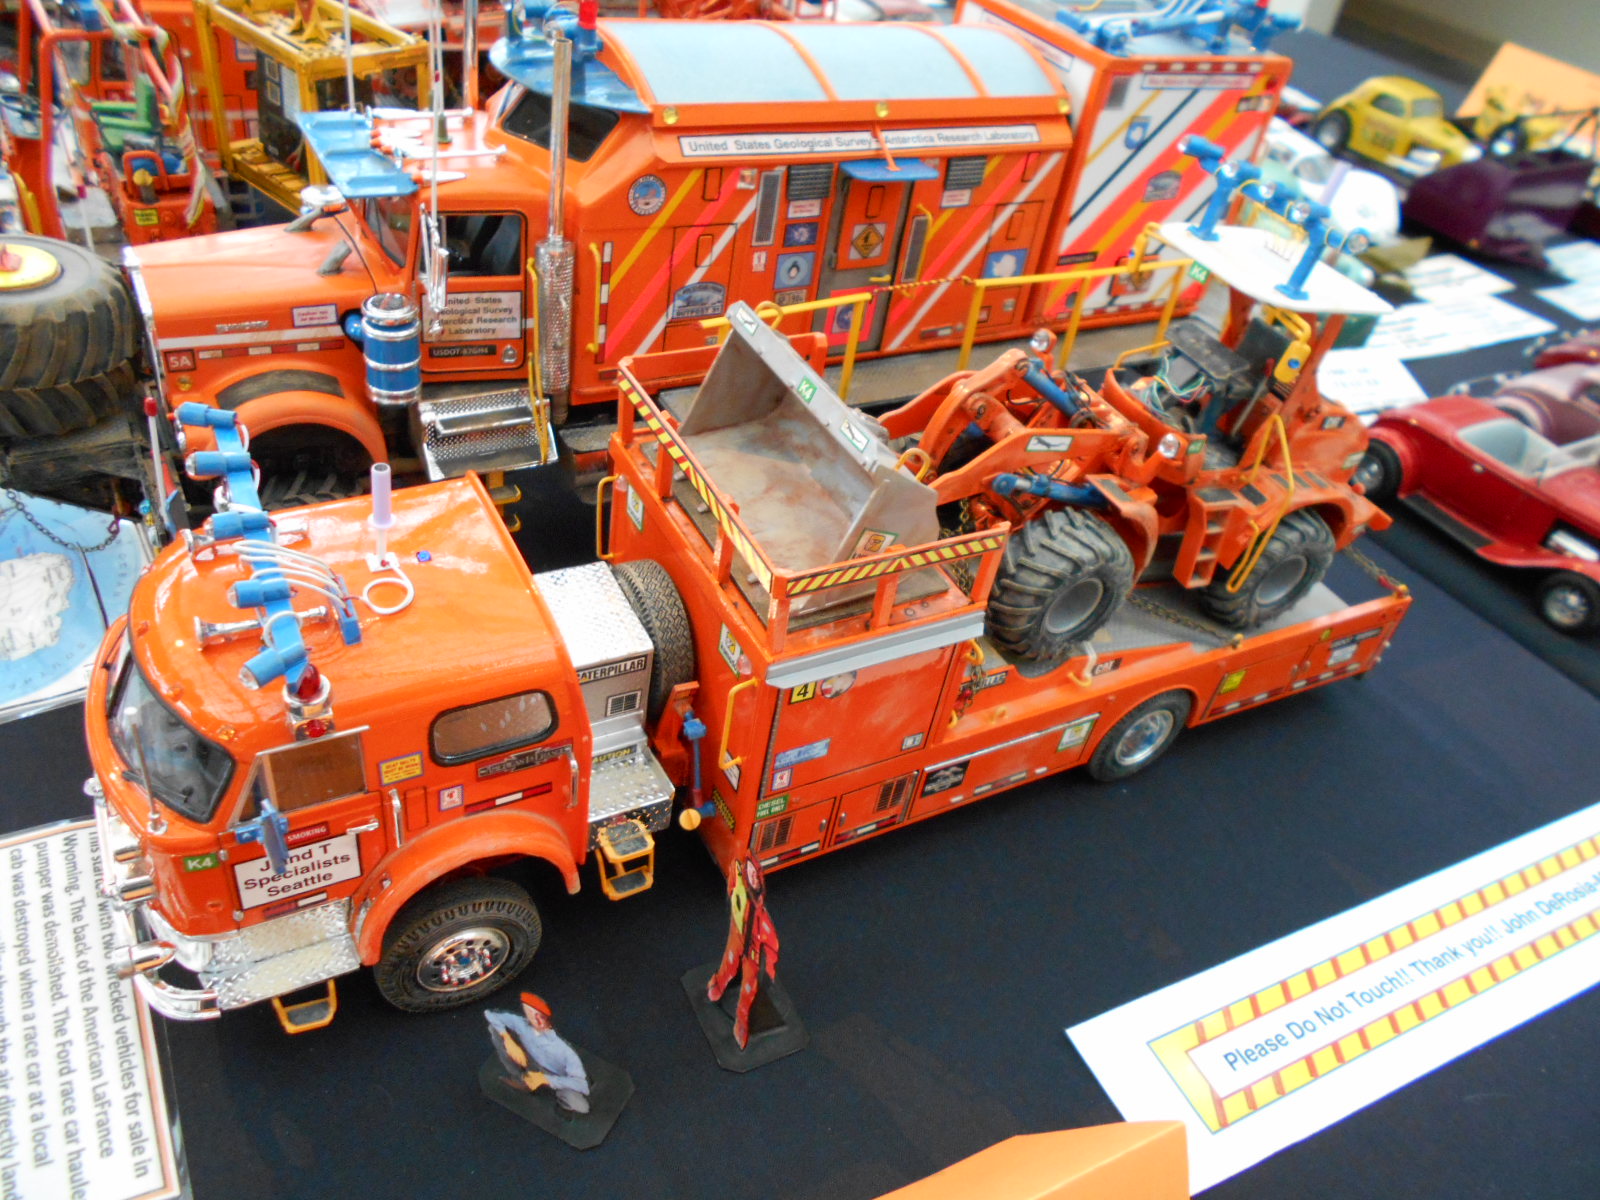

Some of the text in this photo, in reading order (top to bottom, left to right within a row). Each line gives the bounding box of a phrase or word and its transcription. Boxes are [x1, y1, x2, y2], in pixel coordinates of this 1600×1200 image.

[688, 139, 728, 152] United
[734, 138, 771, 150] States
[774, 135, 832, 151] Geological
[835, 134, 872, 148] Survey
[937, 132, 984, 142] Research
[440, 306, 513, 316] eological Survey
[448, 296, 502, 305] nited States
[429, 316, 517, 326] tarctica Research
[448, 327, 496, 335] Laboratory
[796, 683, 809, 698] 4
[593, 748, 631, 763] AUTION
[287, 826, 327, 842] SMOKING
[34, 841, 53, 889] pumper
[244, 854, 351, 890] Specialists
[260, 843, 331, 872] J nd T
[268, 872, 333, 897] Seattle
[42, 893, 54, 919] was
[98, 901, 112, 931] with
[44, 920, 68, 1006] demolished.
[60, 833, 114, 1159] Wyoming. The back of the American LaFrance
[107, 963, 130, 1024] wrecked
[1223, 1033, 1289, 1072] Please
[1285, 1019, 1317, 1040] Do
[1314, 1000, 1352, 1026] Not
[1346, 968, 1414, 1008] Touch!!
[1408, 944, 1462, 977] Thank
[1461, 925, 1504, 957] you!!
[1501, 909, 1541, 934] John
[10, 849, 54, 1168] cab was destroyed when a race car at a local
[52, 1007, 69, 1039] The
[56, 1040, 77, 1078] Ford
[115, 1026, 138, 1091] vehicles
[60, 1080, 76, 1117] race
[125, 1092, 142, 1117] for
[0, 1095, 19, 1160] directly
[64, 1120, 80, 1145] car
[128, 1122, 149, 1157] sale
[134, 1159, 152, 1179] in
